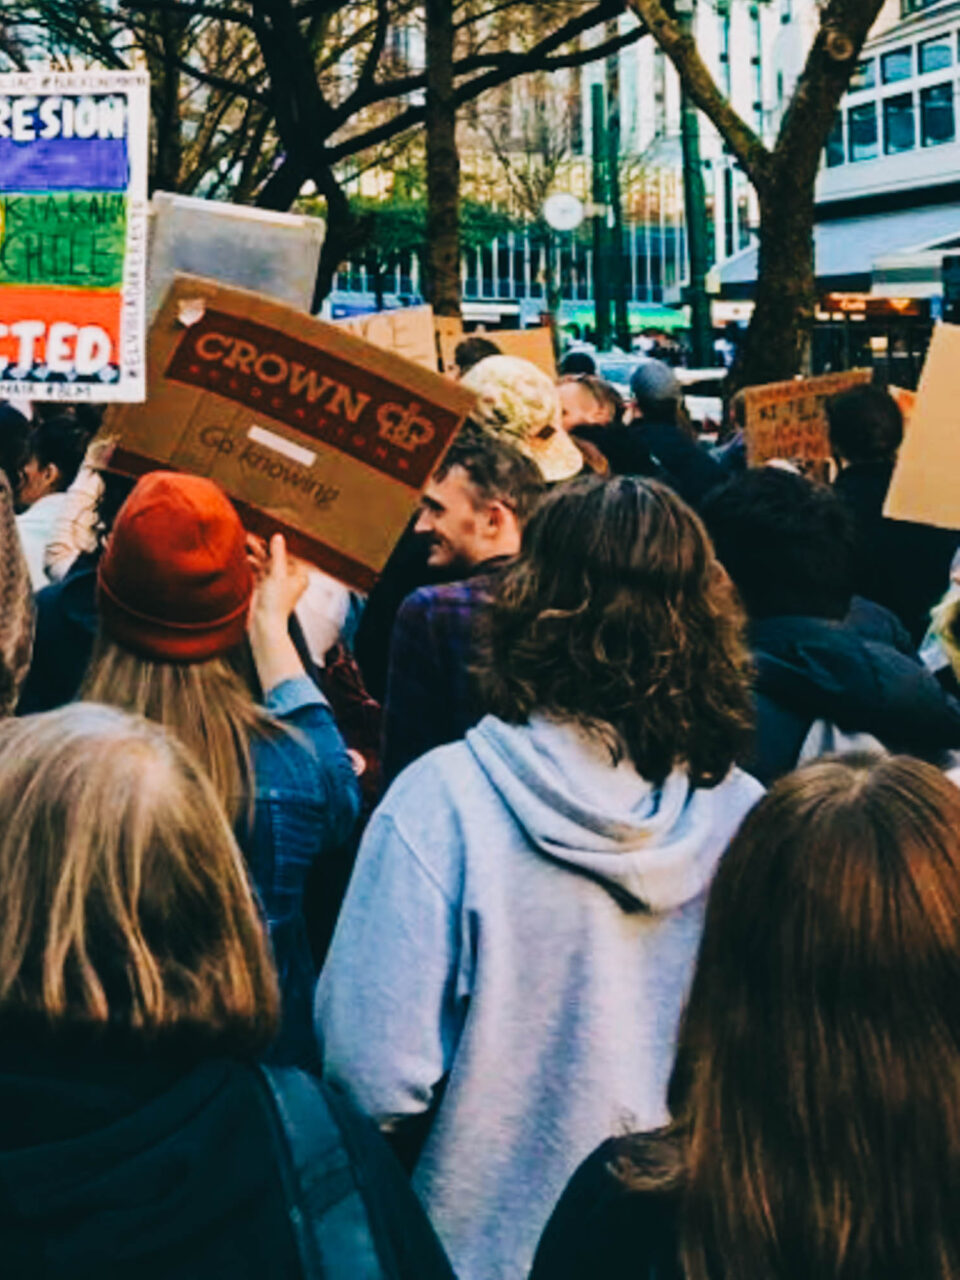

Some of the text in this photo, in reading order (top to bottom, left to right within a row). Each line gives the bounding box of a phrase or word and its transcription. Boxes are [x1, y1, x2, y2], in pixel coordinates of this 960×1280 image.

[0, 227, 113, 283] CHILE
[194, 331, 372, 423] CROWN
[199, 425, 342, 507] Go knowing
